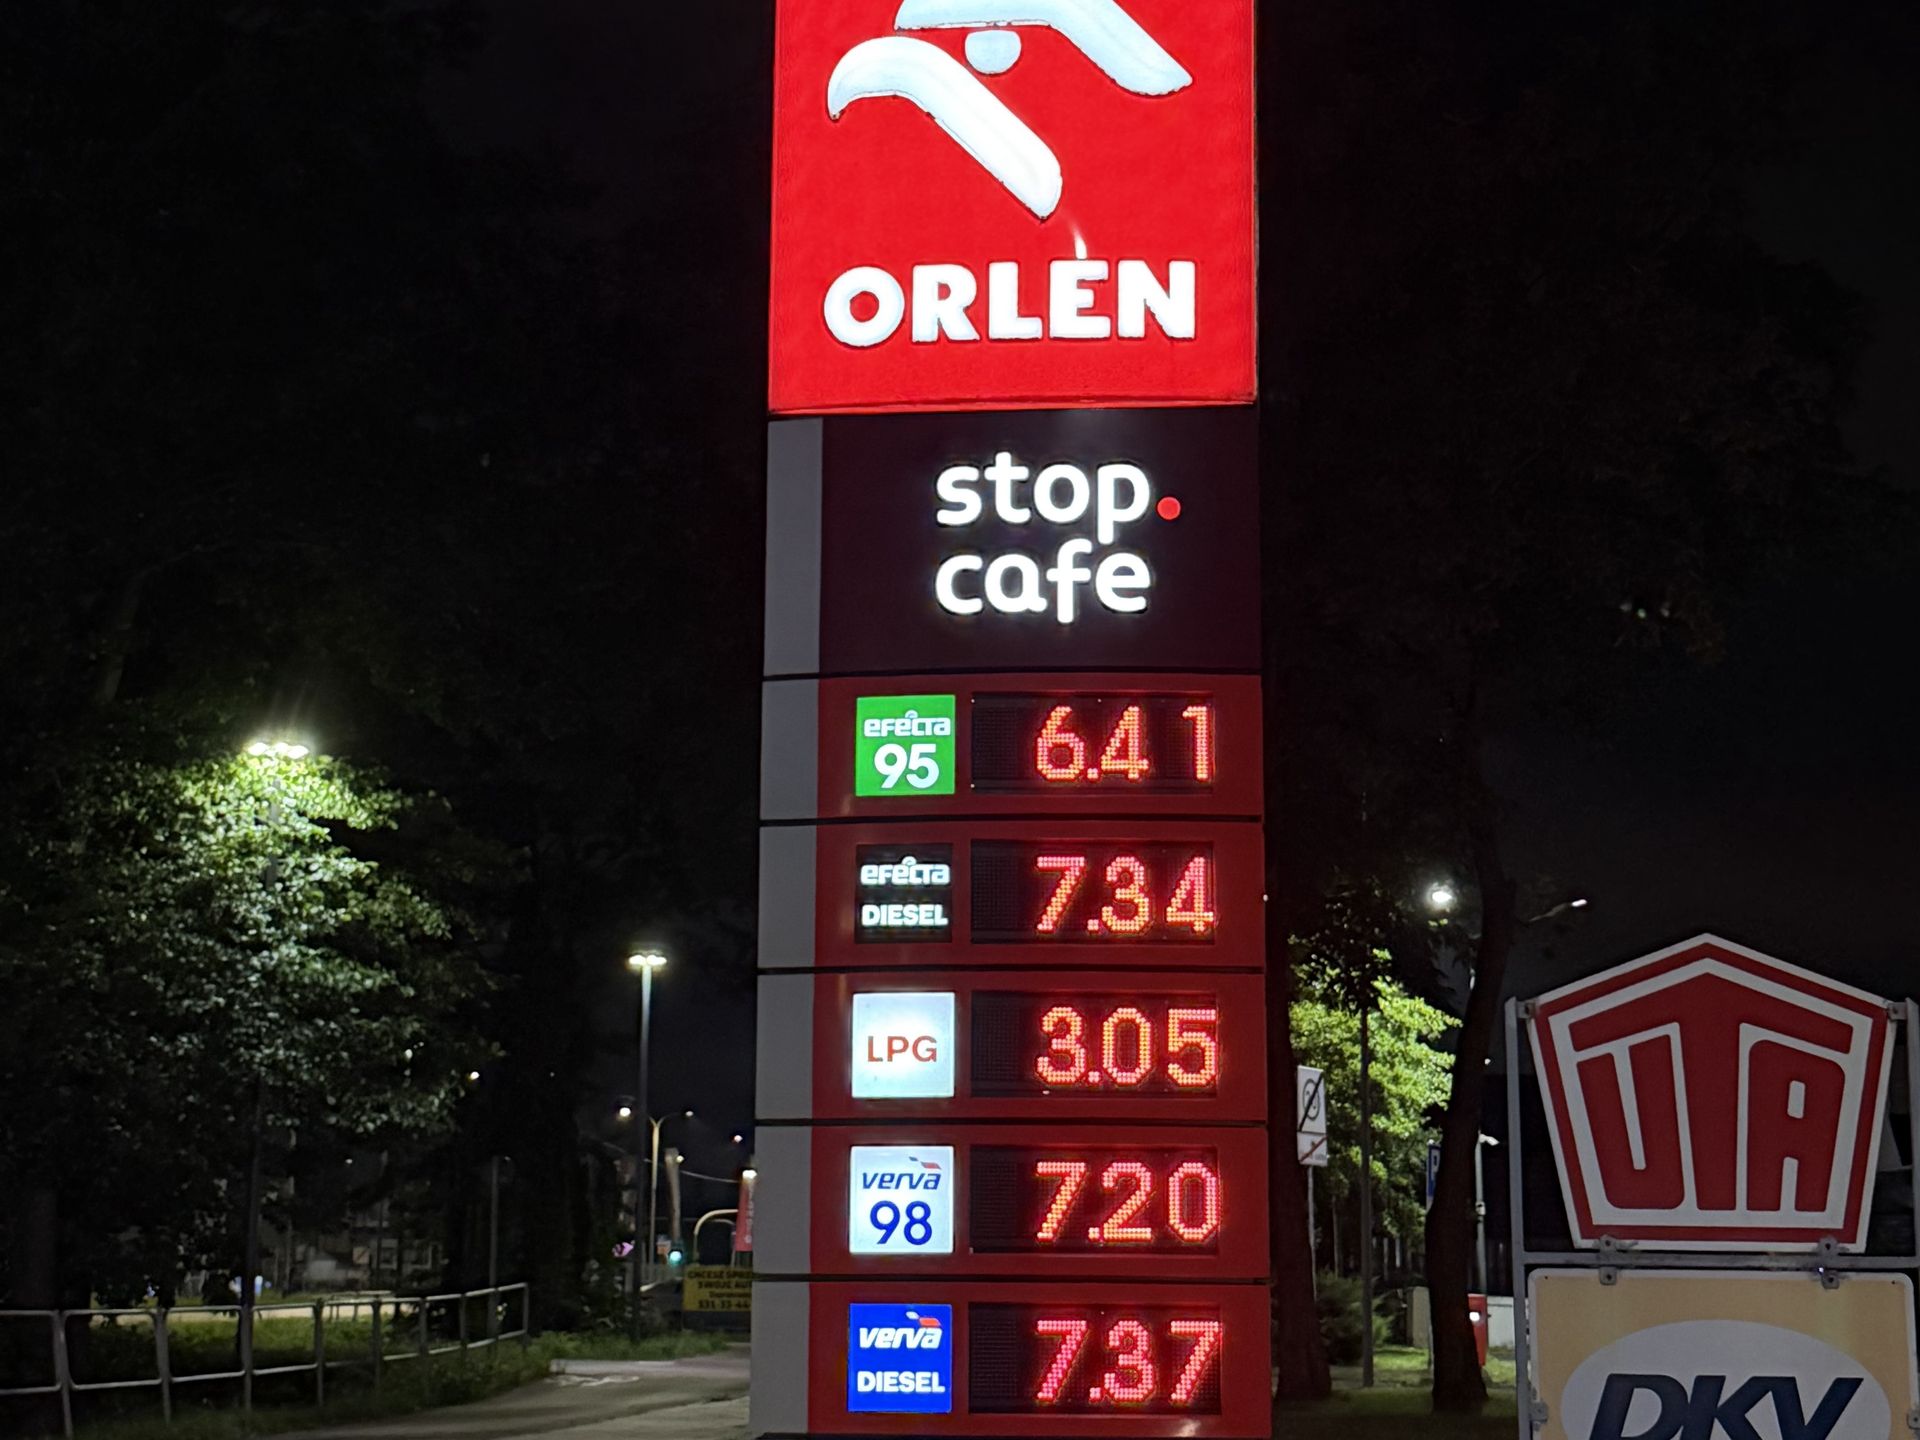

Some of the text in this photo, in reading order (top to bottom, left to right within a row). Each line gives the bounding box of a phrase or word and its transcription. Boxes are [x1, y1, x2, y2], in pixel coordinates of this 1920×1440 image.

[823, 260, 1195, 347] ORLEN
[935, 538, 1151, 624] cafe
[873, 743, 939, 789] 95
[1036, 705, 1209, 780] 6.41
[861, 904, 948, 927] DIESEL
[1036, 856, 1215, 932] 7.34
[866, 1035, 937, 1063] LPG
[1036, 1007, 1217, 1085] 3.05
[1568, 971, 1855, 1213] UTA
[861, 1170, 941, 1190] verva
[1036, 1161, 1217, 1243] 7.20
[869, 1200, 932, 1245] 98
[859, 1326, 942, 1349] verva
[1036, 1320, 1220, 1403] 7.37
[857, 1371, 945, 1393] DIESEL
[1589, 1373, 1865, 1440] DKV
